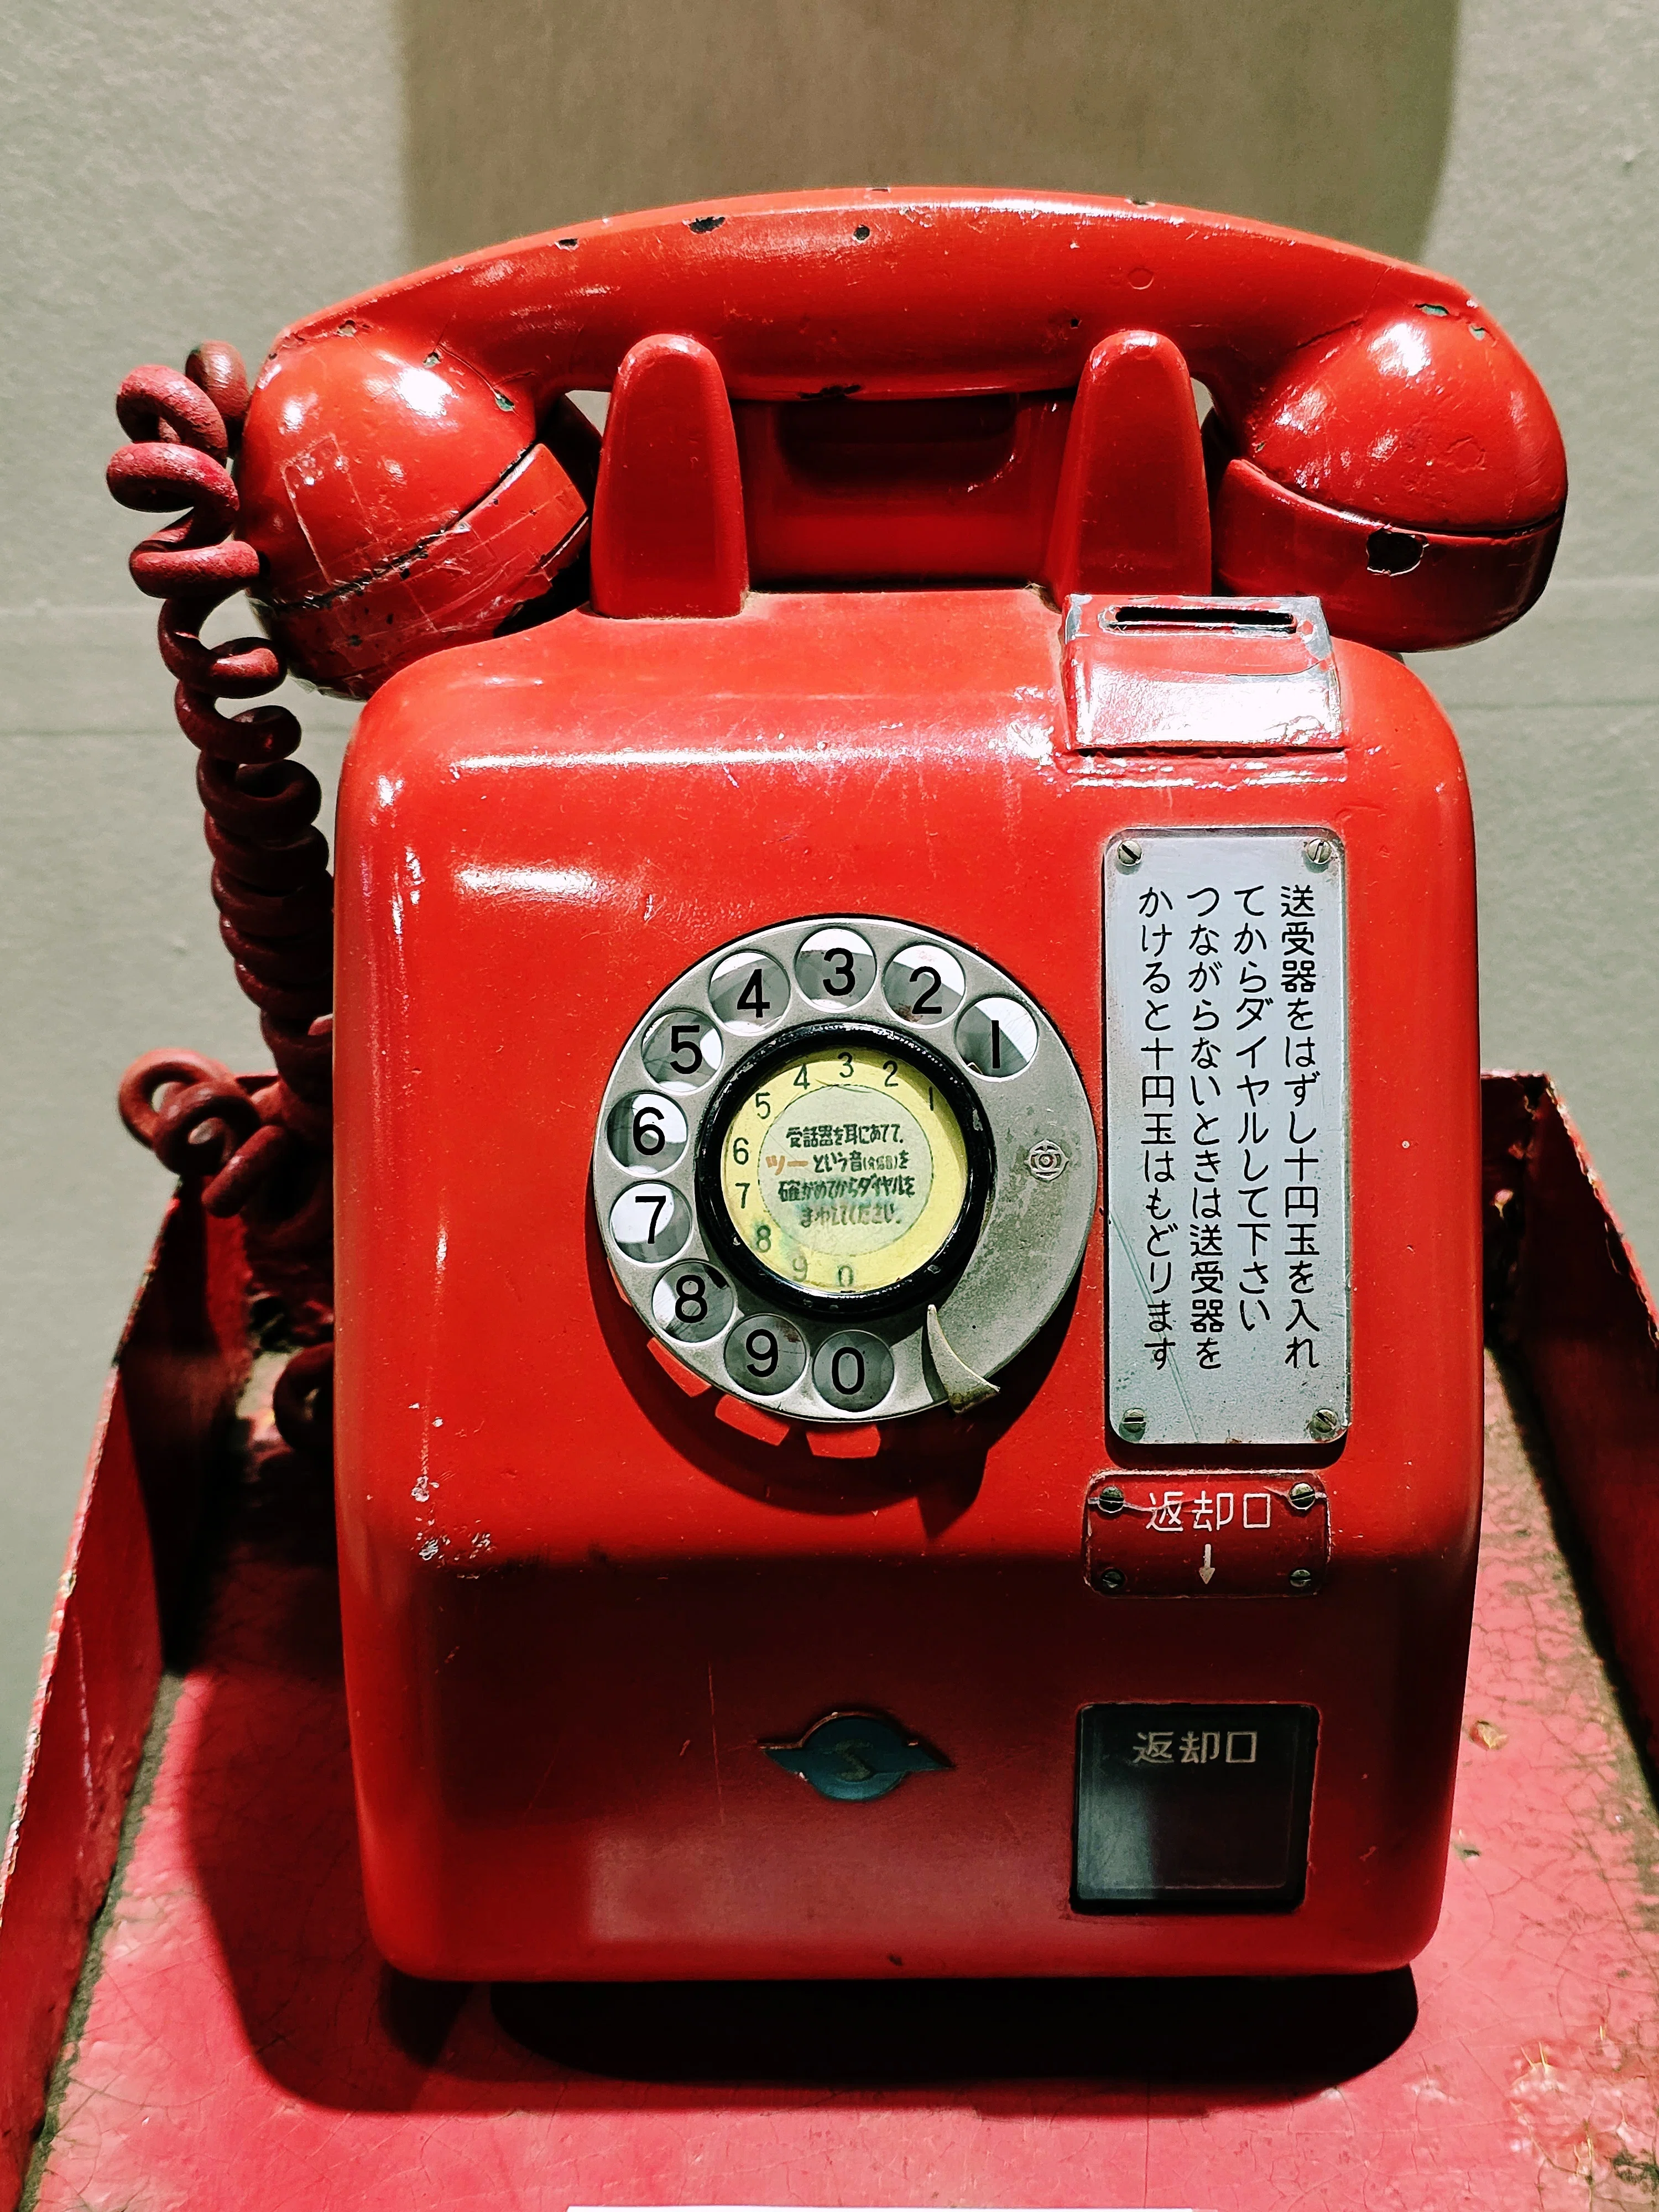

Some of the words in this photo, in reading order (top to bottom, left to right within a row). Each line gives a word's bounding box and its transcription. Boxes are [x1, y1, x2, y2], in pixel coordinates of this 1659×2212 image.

[737, 968, 770, 1018] 4
[822, 947, 855, 997] 3
[909, 966, 942, 1015] 2
[670, 1025, 703, 1074] 5
[837, 1052, 854, 1078] 3
[991, 1020, 1001, 1069] 1
[792, 1063, 810, 1090] 4
[883, 1060, 899, 1087] 2
[755, 1092, 771, 1120] 5
[927, 1086, 935, 1112] 1
[1234, 885, 1274, 1332] てからダイヤルして下さい
[633, 1107, 665, 1156] 6
[1139, 886, 1178, 1370] かけると十円玉はもどります
[1187, 887, 1225, 1370] つながらないときは送受器を
[1281, 884, 1321, 1369] 送受器をはずし十円玉を入れ
[732, 1138, 749, 1165] 6
[635, 1195, 666, 1244] 7
[734, 1182, 751, 1209] 7
[756, 1225, 771, 1253] 8
[791, 1255, 808, 1282] 9
[838, 1264, 854, 1287] 0
[675, 1274, 708, 1324] 8
[745, 1328, 779, 1378] 9
[831, 1347, 865, 1395] 0
[1145, 1490, 1271, 1532] 返却口
[1133, 1731, 1258, 1764] 返却口
